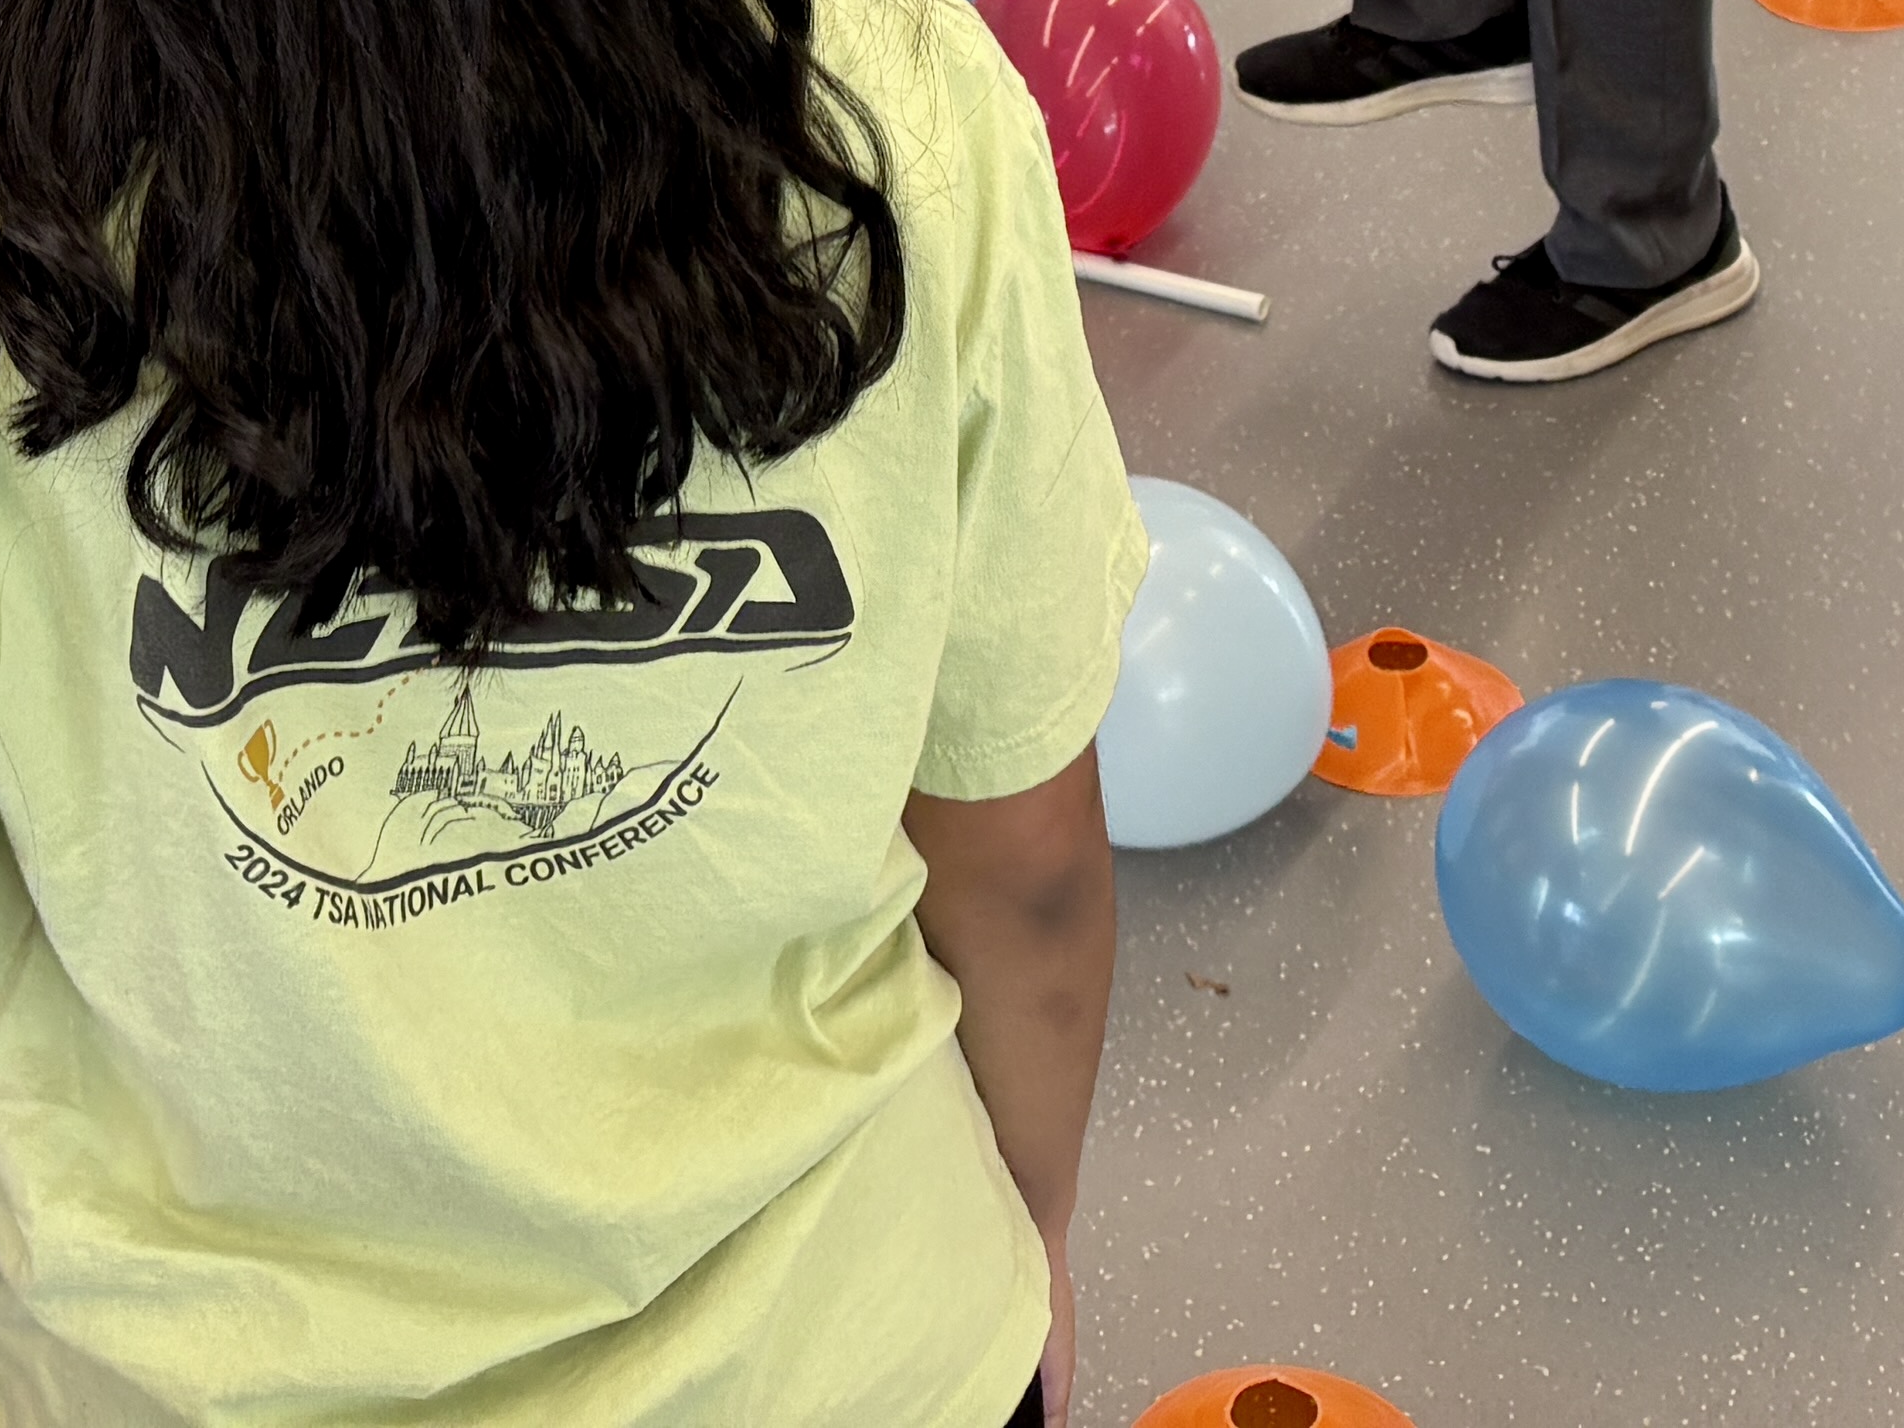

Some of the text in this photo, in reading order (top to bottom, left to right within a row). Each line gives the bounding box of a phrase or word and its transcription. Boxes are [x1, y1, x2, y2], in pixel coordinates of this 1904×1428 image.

[223, 761, 721, 931] 2024 TSA NATIONAL CONFERENCE
[276, 755, 345, 836] ORLANDO
